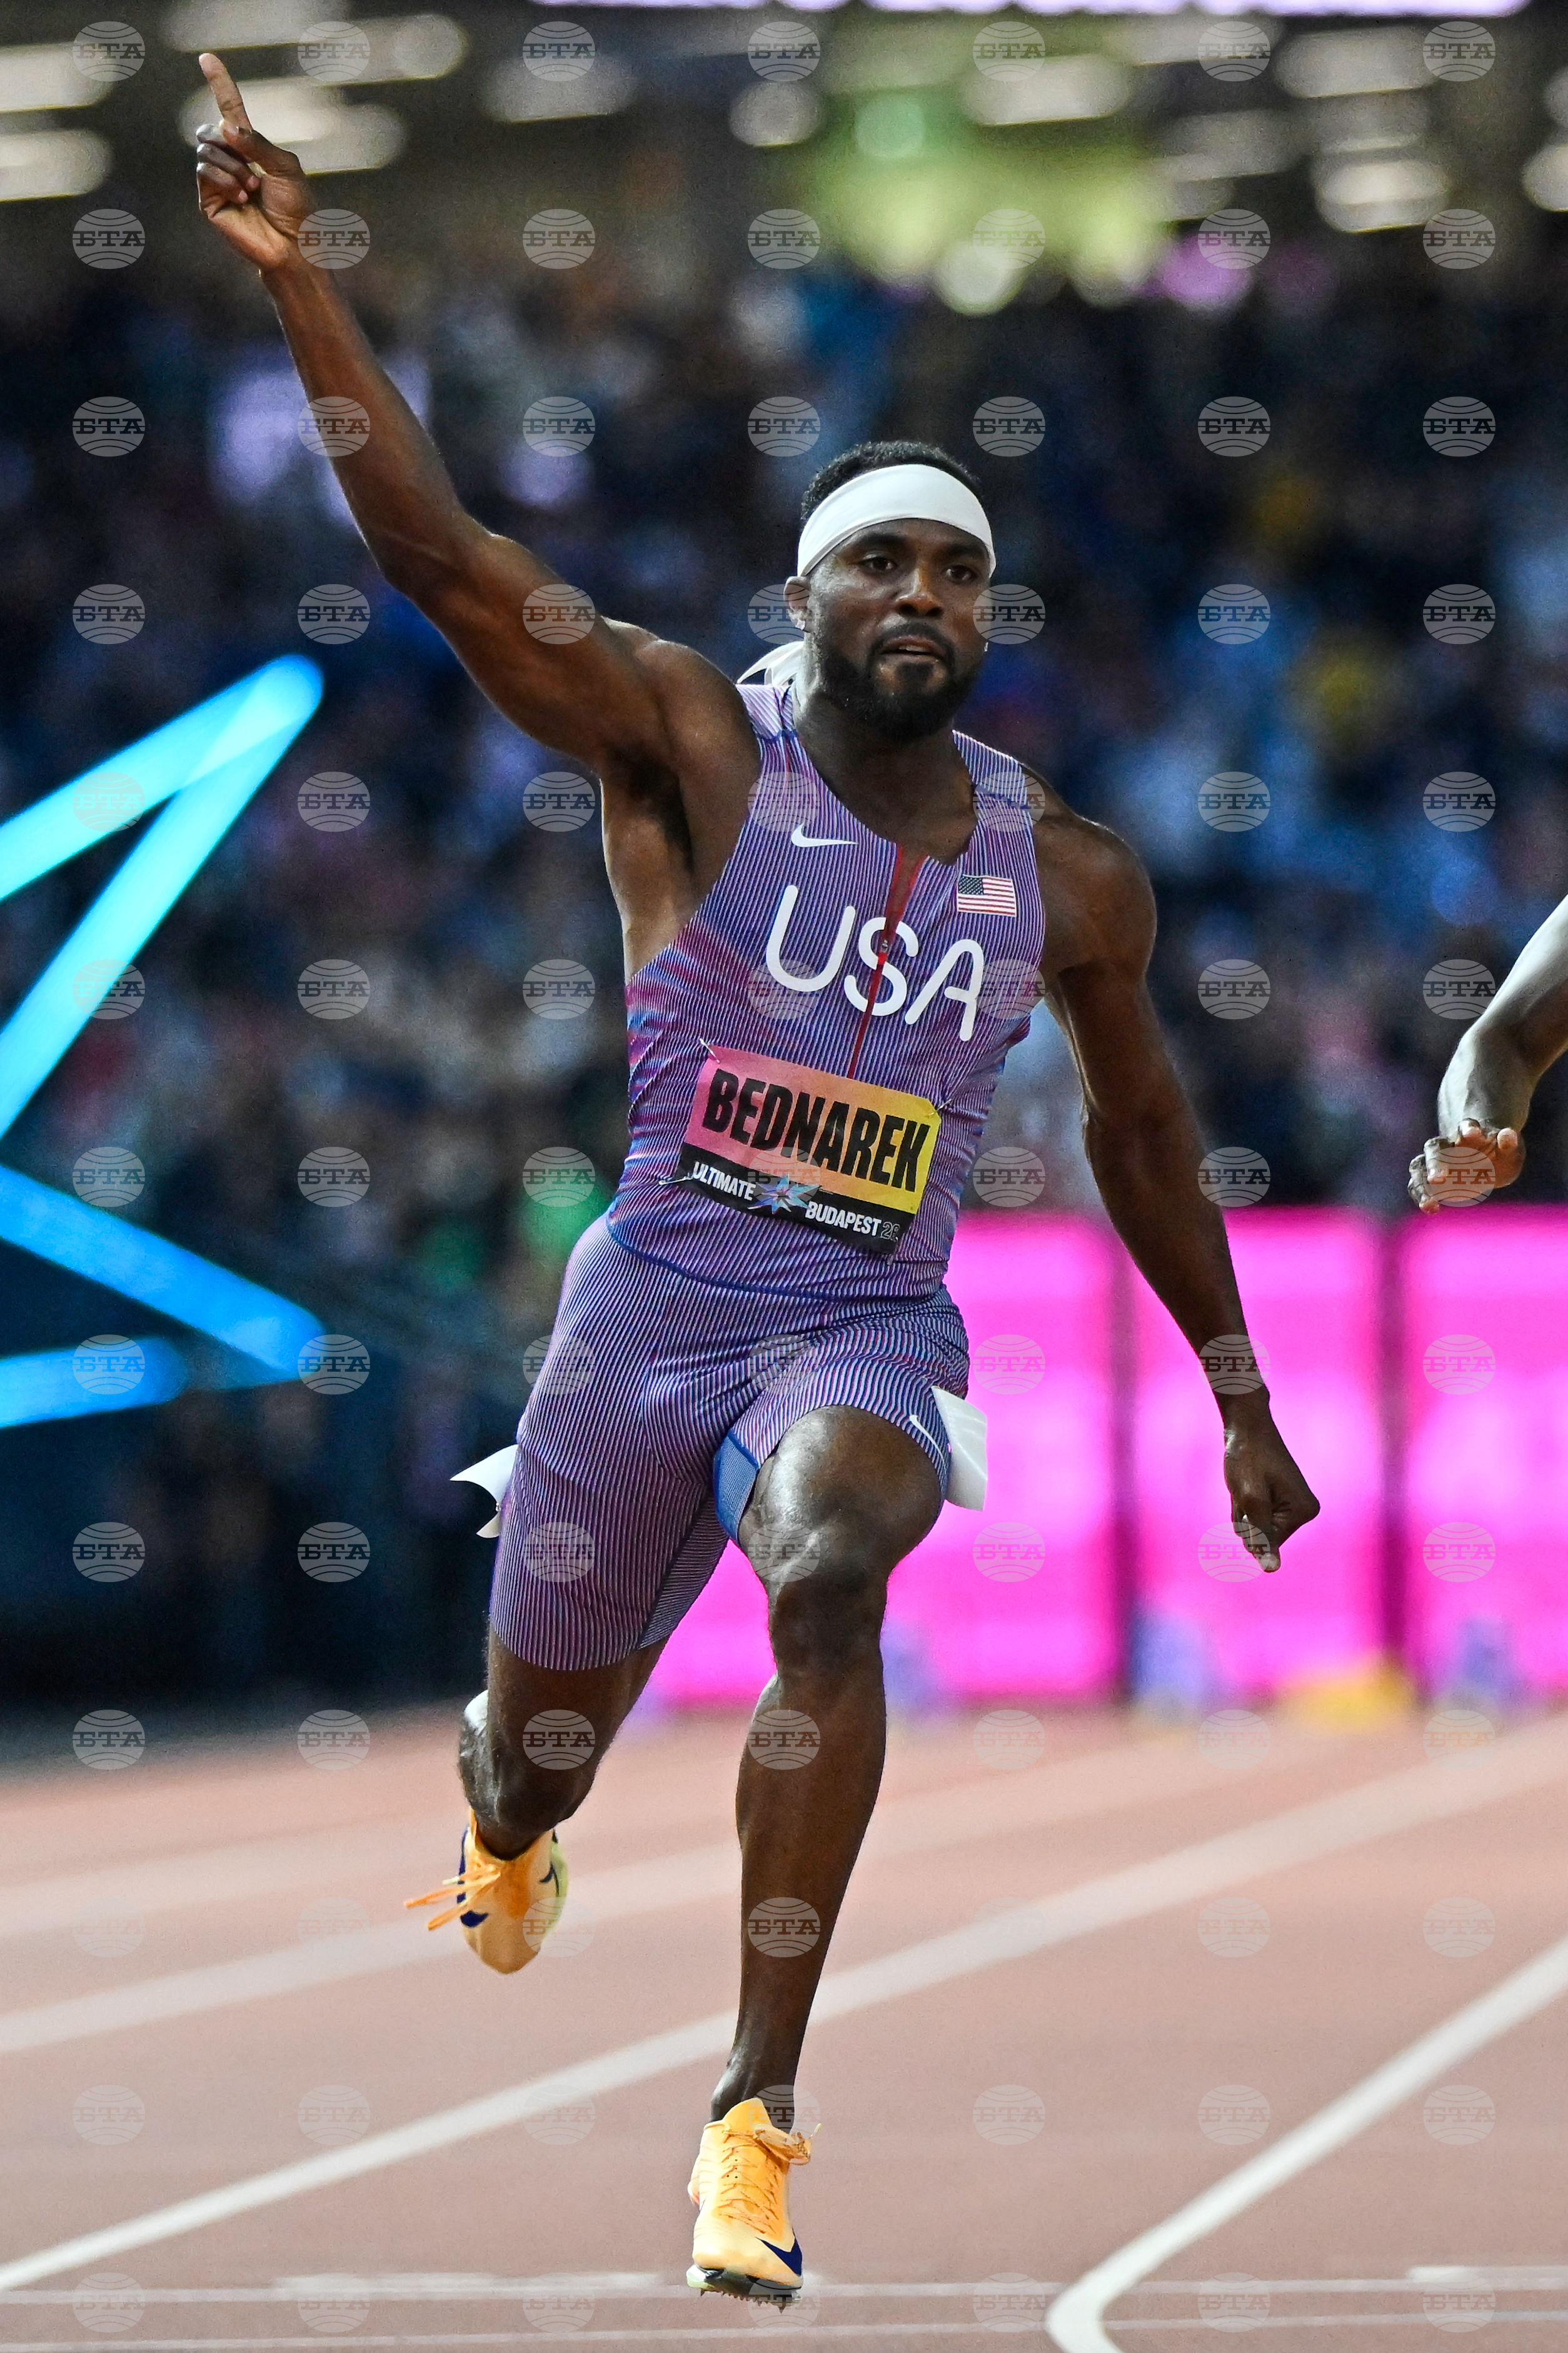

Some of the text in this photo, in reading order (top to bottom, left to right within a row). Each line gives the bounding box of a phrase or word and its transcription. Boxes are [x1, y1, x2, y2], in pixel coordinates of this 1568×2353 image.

[766, 885, 984, 1042] USA
[703, 1069, 930, 1192] BEDNAREK
[692, 1161, 756, 1201] ULTIMATE
[805, 1201, 882, 1236] BUDAPEST
